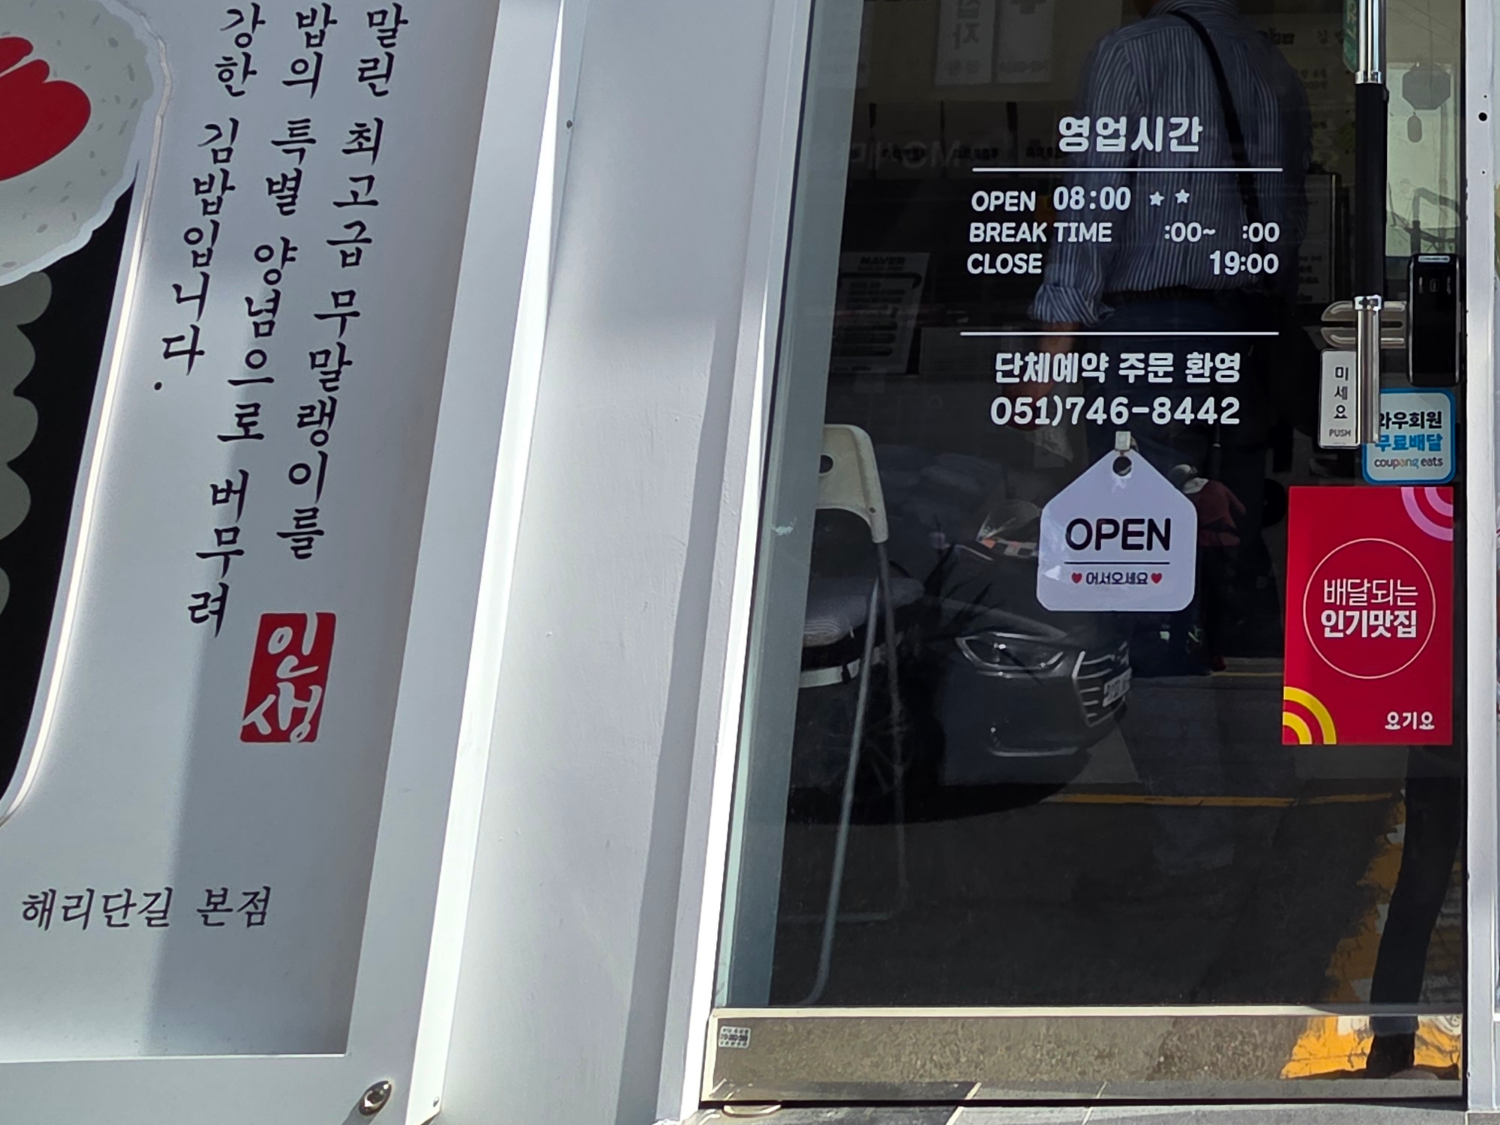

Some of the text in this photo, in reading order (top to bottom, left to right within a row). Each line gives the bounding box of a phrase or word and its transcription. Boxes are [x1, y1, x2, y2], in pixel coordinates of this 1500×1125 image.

[214, 3, 266, 97] 강한
[357, 2, 409, 98] 말린
[1058, 116, 1203, 153] 영업시간
[266, 117, 317, 216] 특별
[326, 117, 384, 270] 최고급
[971, 186, 1131, 212] OPEN 08:00
[969, 222, 1048, 243] BREAK
[1053, 222, 1112, 243] TIME
[154, 117, 241, 391] 김밥입니다.
[967, 253, 1043, 275] CLOSE
[1209, 250, 1280, 276] 19:00
[217, 235, 298, 442] 양념으로
[995, 352, 1241, 384] 단체예약 주문 환영
[990, 395, 1241, 426] 051)746-8442
[1333, 366, 1350, 420] 미세요
[277, 289, 359, 560] 무말랭이를
[1329, 429, 1351, 437] PUSH
[1375, 433, 1443, 452] 무료배달
[1374, 456, 1444, 469] coupang eats
[1065, 517, 1172, 552] OPEN
[188, 468, 251, 638] 버무려
[1086, 571, 1149, 586] 어서오세요
[1323, 578, 1418, 607] 배달되는
[1321, 608, 1418, 638] 인기맛집
[243, 612, 335, 743] 인생
[1385, 711, 1435, 730] 요기요
[22, 886, 273, 931] 해리단길 본점
